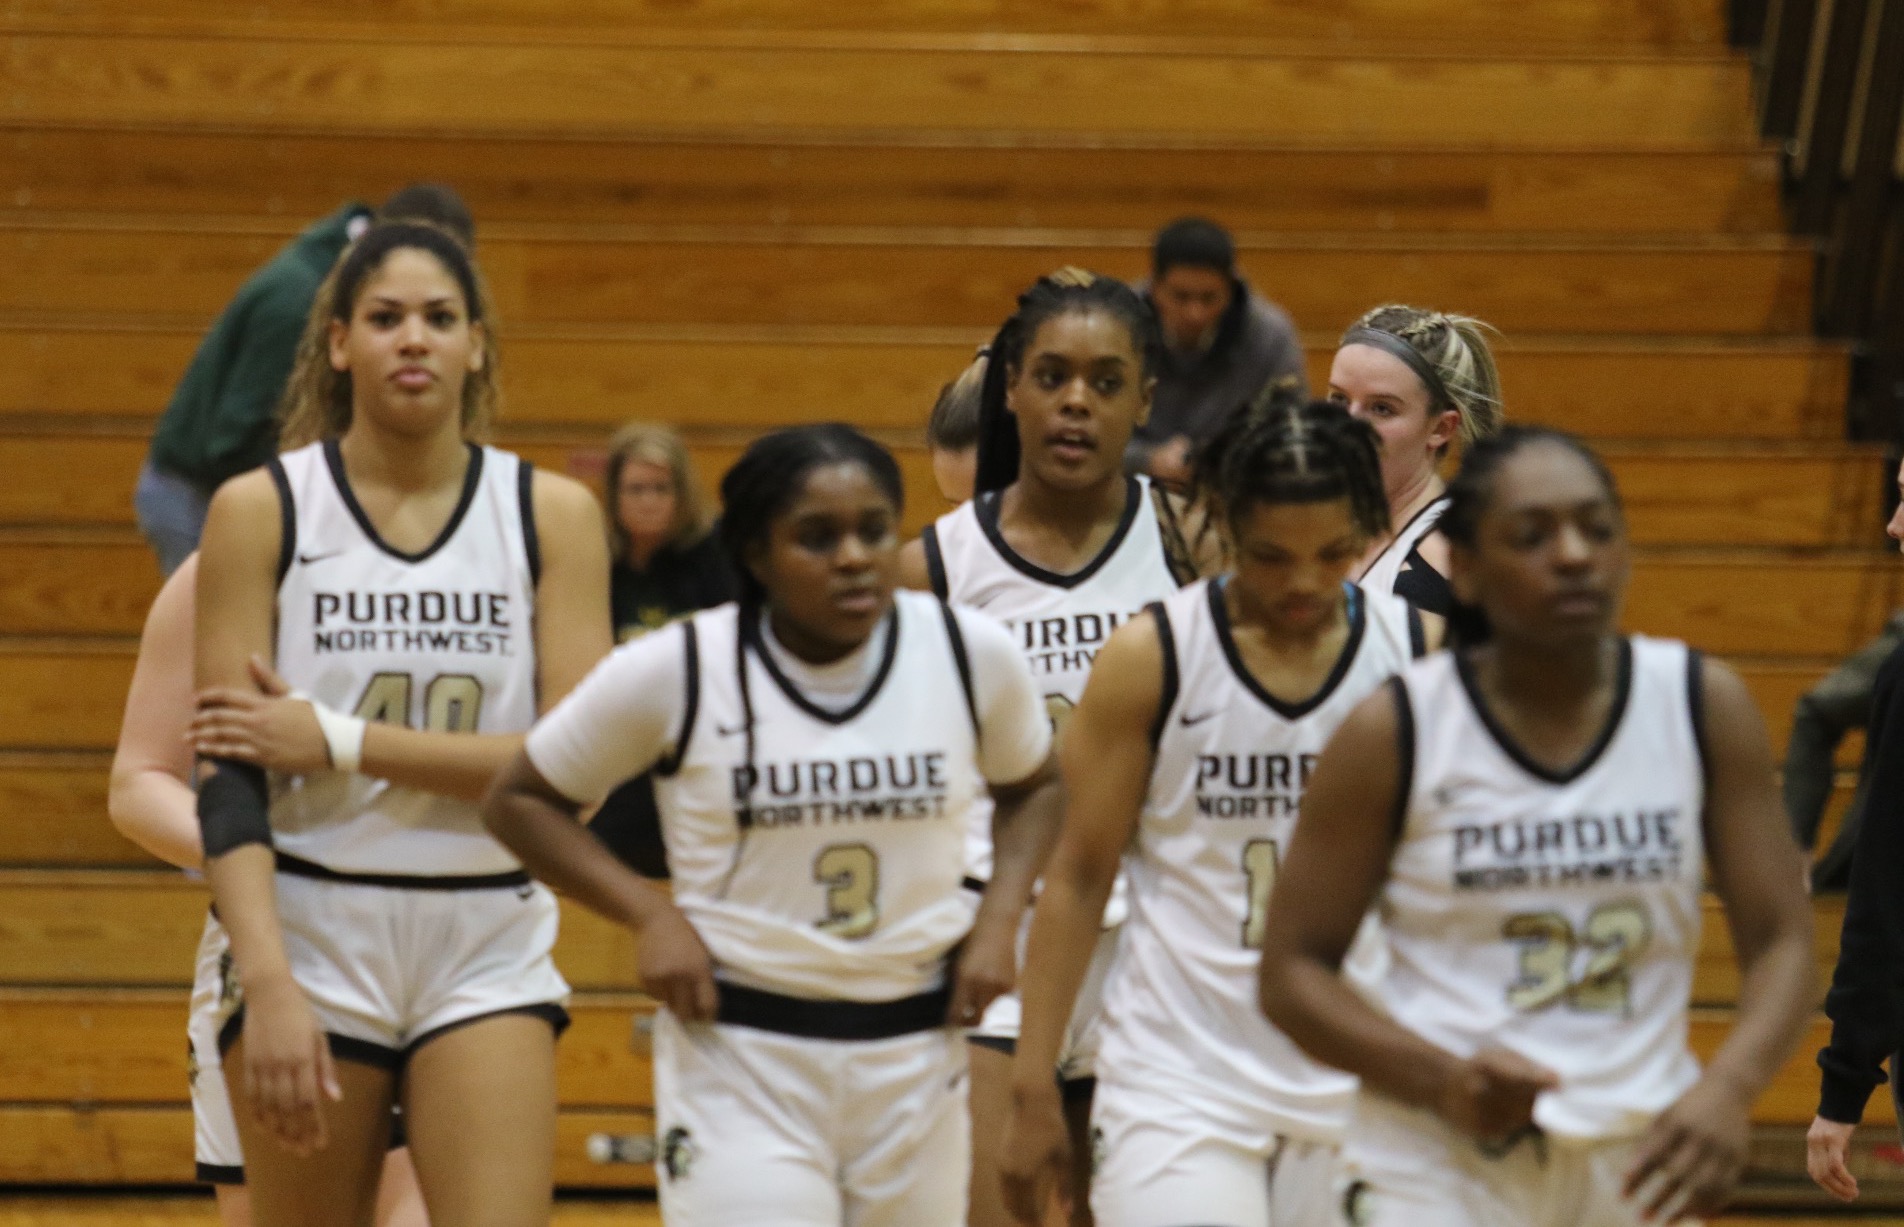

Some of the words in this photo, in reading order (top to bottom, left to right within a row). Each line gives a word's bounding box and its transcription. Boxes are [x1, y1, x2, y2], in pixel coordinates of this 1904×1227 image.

[314, 592, 509, 628] PURDUE
[314, 629, 516, 656] NORTHWEST
[733, 752, 946, 800] PURDUE
[1197, 753, 1320, 790] PUR
[1454, 809, 1681, 864] PURDUE
[812, 843, 881, 941] 3
[1502, 899, 1652, 1019] 32
